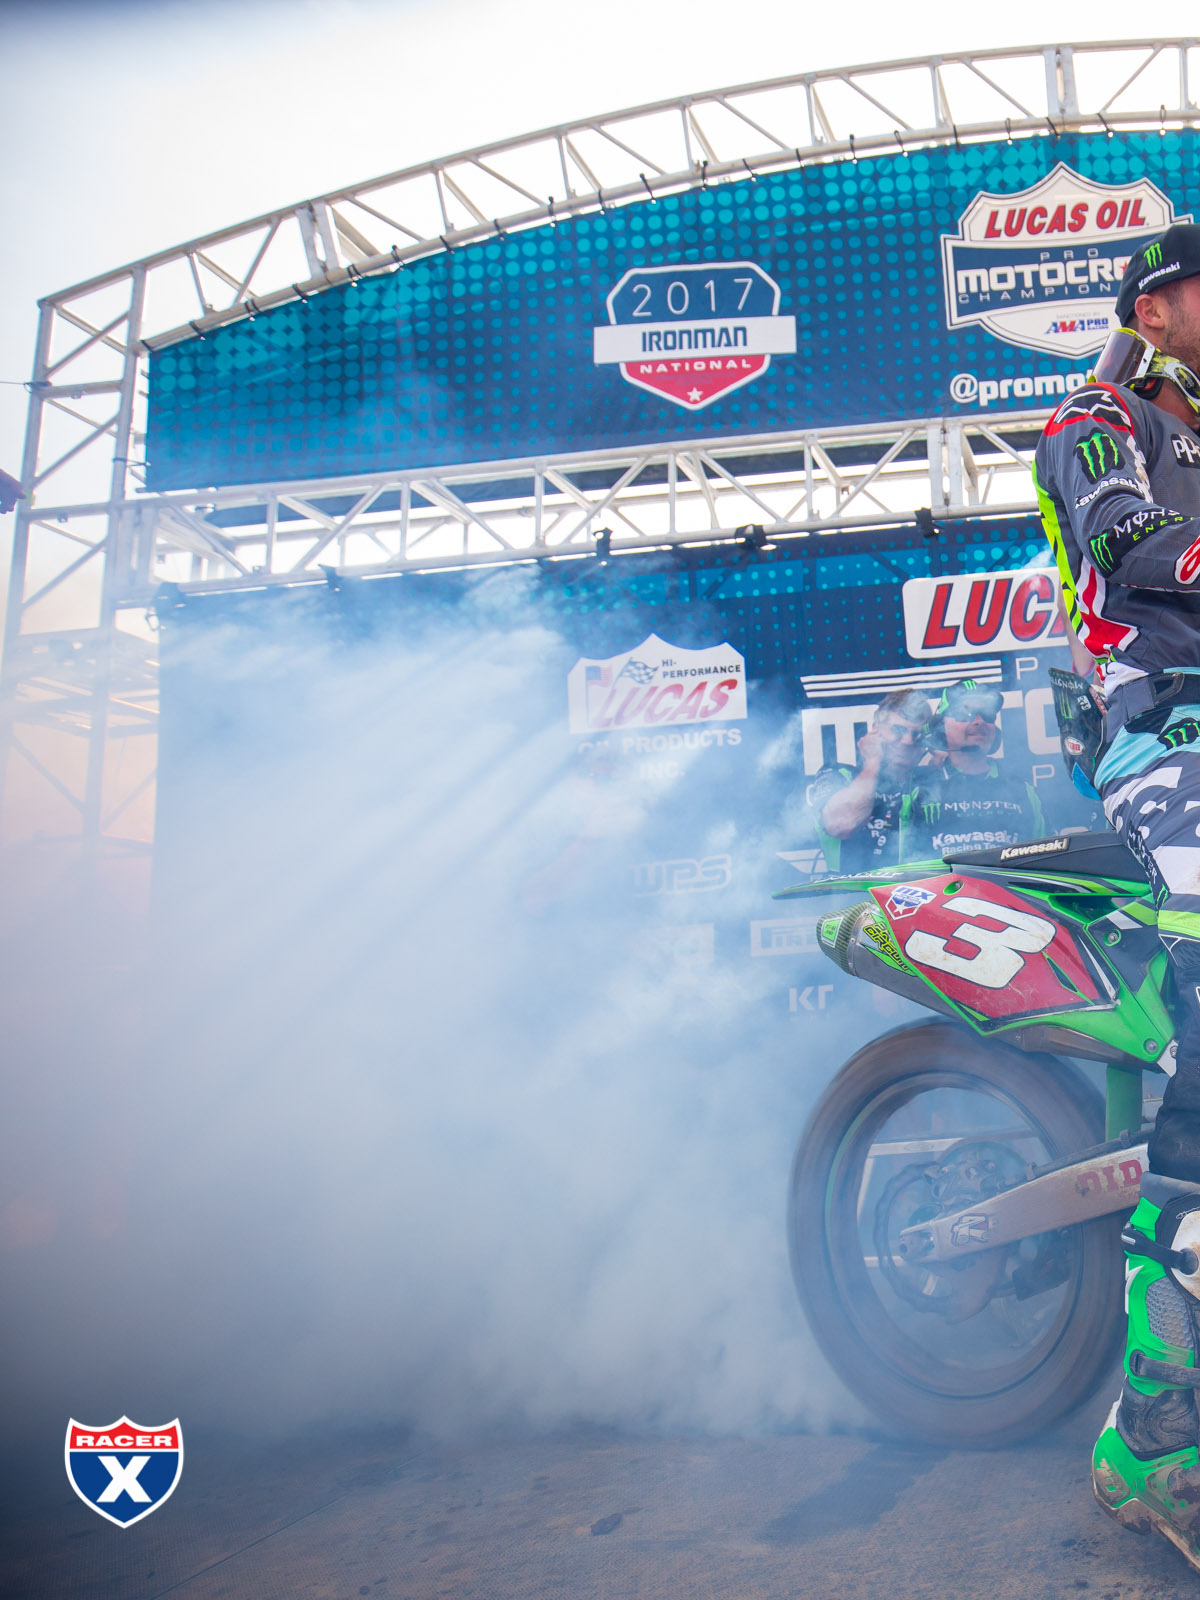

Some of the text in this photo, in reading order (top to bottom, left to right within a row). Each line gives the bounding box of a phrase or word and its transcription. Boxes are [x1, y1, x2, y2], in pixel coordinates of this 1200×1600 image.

[984, 198, 1146, 239] LUCAS OIL
[1040, 248, 1099, 261] PRO
[956, 256, 1132, 293] MOTOCRO
[1138, 262, 1180, 290] Kawasaki
[632, 278, 753, 317] 2017
[958, 283, 1111, 304] CHAMPION
[642, 326, 748, 352] IRONMAN
[1044, 317, 1109, 335] AMA PRO
[640, 359, 752, 374] NATIONAL
[950, 369, 1092, 407] @promo
[662, 664, 742, 679] PERFORMANCE
[592, 678, 738, 729] LUCAS
[621, 727, 742, 754] PRODUCTS
[944, 800, 1023, 815] MONSTER
[932, 829, 1019, 850] Kawasaki
[1000, 838, 1068, 861] Kawasaki
[904, 896, 1056, 989] 3
